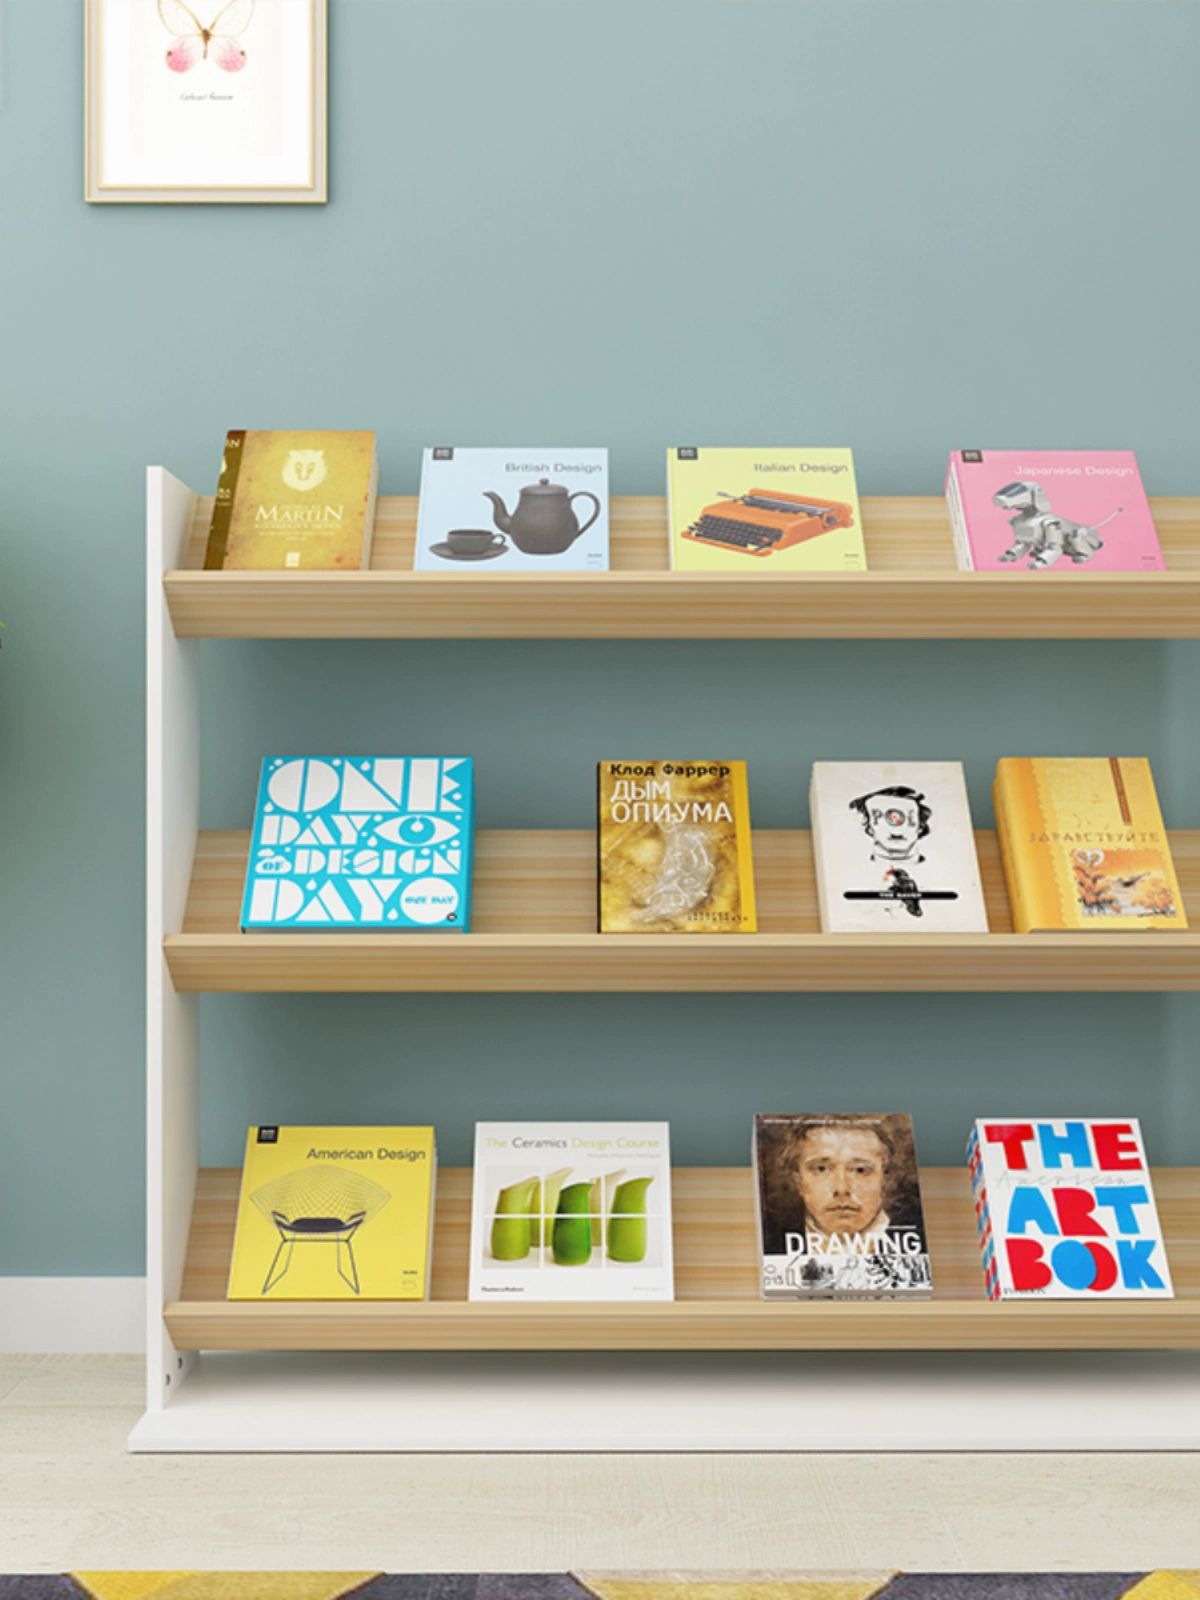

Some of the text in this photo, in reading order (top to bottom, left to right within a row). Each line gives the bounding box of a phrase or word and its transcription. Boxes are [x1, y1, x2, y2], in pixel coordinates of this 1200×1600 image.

[505, 463, 602, 474] British Design
[754, 463, 848, 474] Italian Design
[1014, 465, 1134, 476] Japanese Design
[255, 504, 344, 522] MARTIN
[610, 763, 731, 777] Клод Фаррер
[267, 758, 467, 812] ONE
[610, 780, 671, 803] ДЫМ
[611, 802, 733, 823] ОПИУМА
[260, 814, 372, 845] DAY
[293, 848, 462, 875] DESIGN
[248, 878, 404, 922] DAY
[306, 1147, 426, 1162] American Design
[485, 1137, 660, 1151] The Ceramics Design Course
[984, 1122, 1144, 1172] THE
[1007, 1185, 1150, 1237] ART
[785, 1231, 922, 1257] DRAWING
[1004, 1238, 1167, 1292] BOOK
